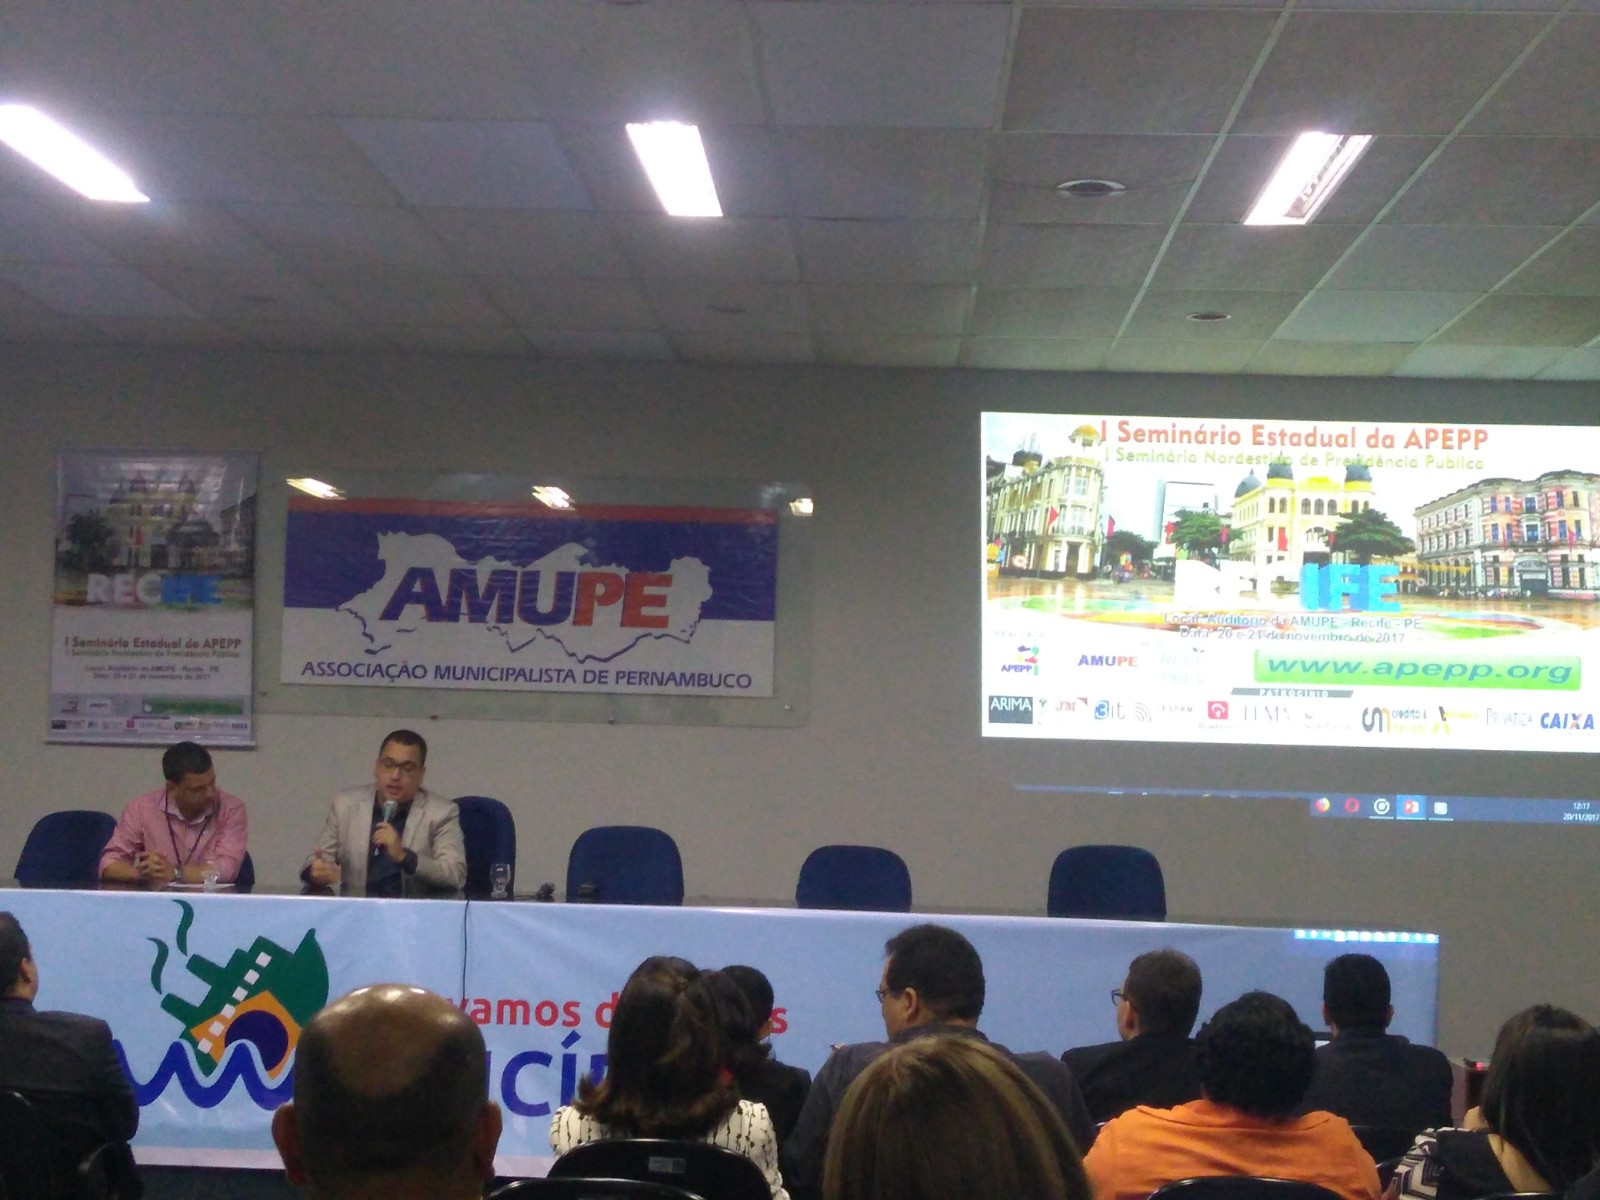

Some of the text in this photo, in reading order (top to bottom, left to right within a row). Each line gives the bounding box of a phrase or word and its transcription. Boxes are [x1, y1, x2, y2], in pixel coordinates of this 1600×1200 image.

[1101, 420, 1488, 450] I Seminário Estadual da APEPP
[1116, 447, 1197, 464] Seminário
[1300, 453, 1318, 467] de
[378, 566, 673, 628] AMUPE
[1290, 616, 1339, 628] AMUPE
[1404, 618, 1423, 630] PE
[203, 638, 241, 649] APEPP
[1376, 633, 1405, 643] 2017
[1078, 655, 1138, 668] AMUPE
[301, 660, 752, 688] ASSOCIAÇÃO MUNICIPALISTA DE PERNAMBUCO
[1268, 658, 1572, 684] www.apepp.org
[990, 697, 1032, 711] ARIMA
[1541, 712, 1595, 730] CAIXA
